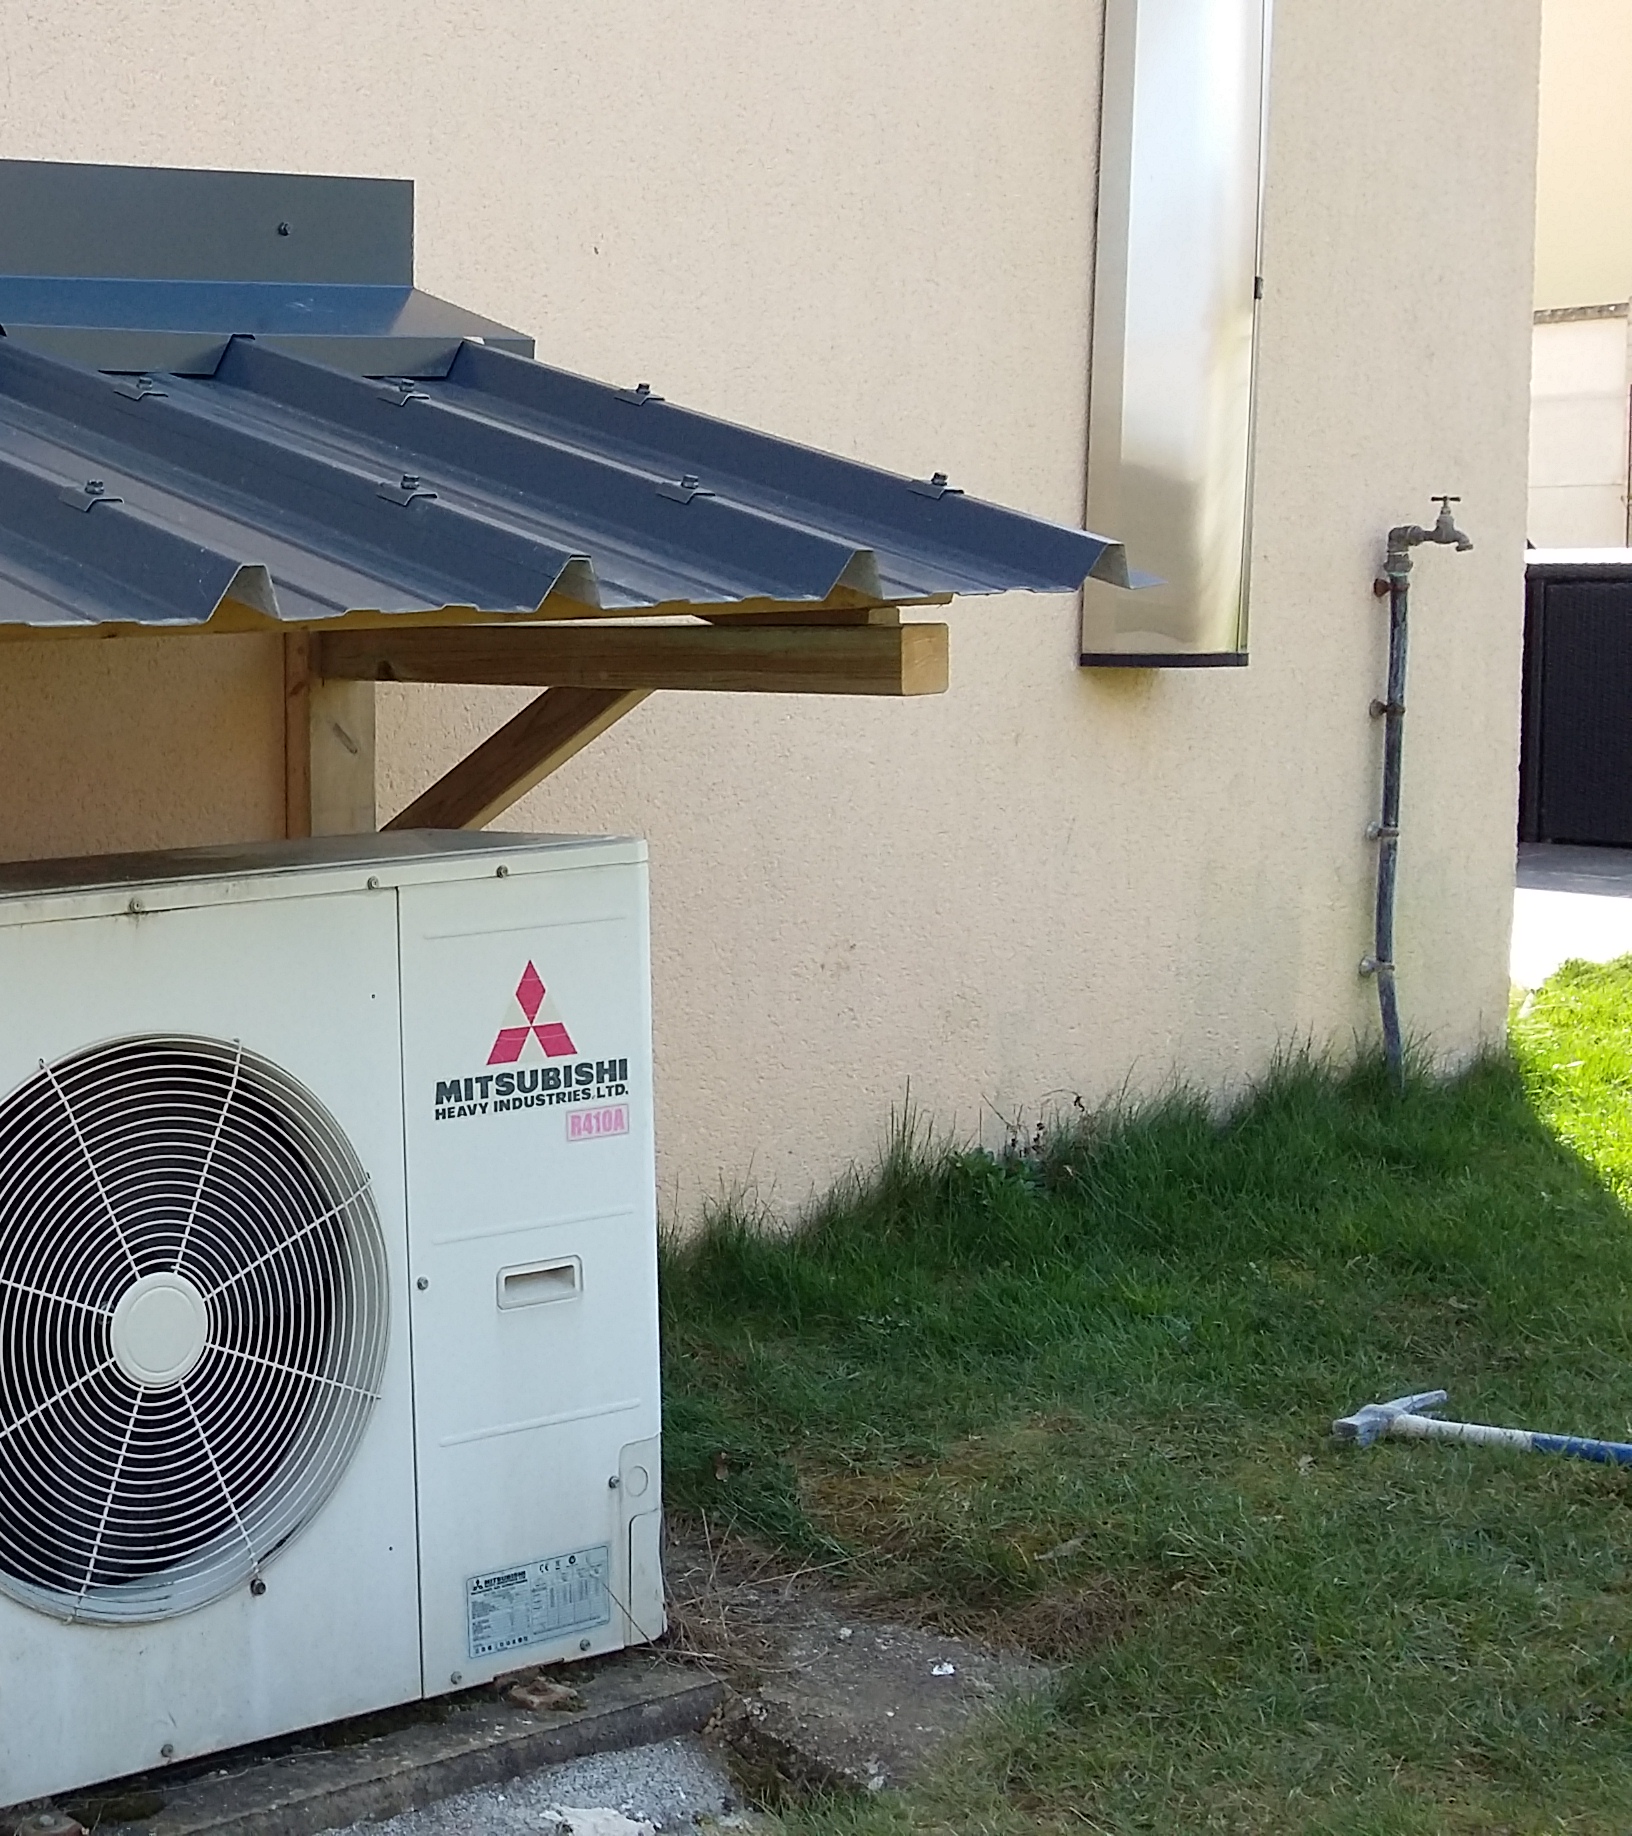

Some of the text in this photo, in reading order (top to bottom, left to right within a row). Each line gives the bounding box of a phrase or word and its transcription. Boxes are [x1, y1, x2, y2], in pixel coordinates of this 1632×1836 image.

[435, 1058, 628, 1105] MITSUBISHI
[434, 1102, 489, 1121] HEAVY
[570, 1108, 625, 1137] R410A
